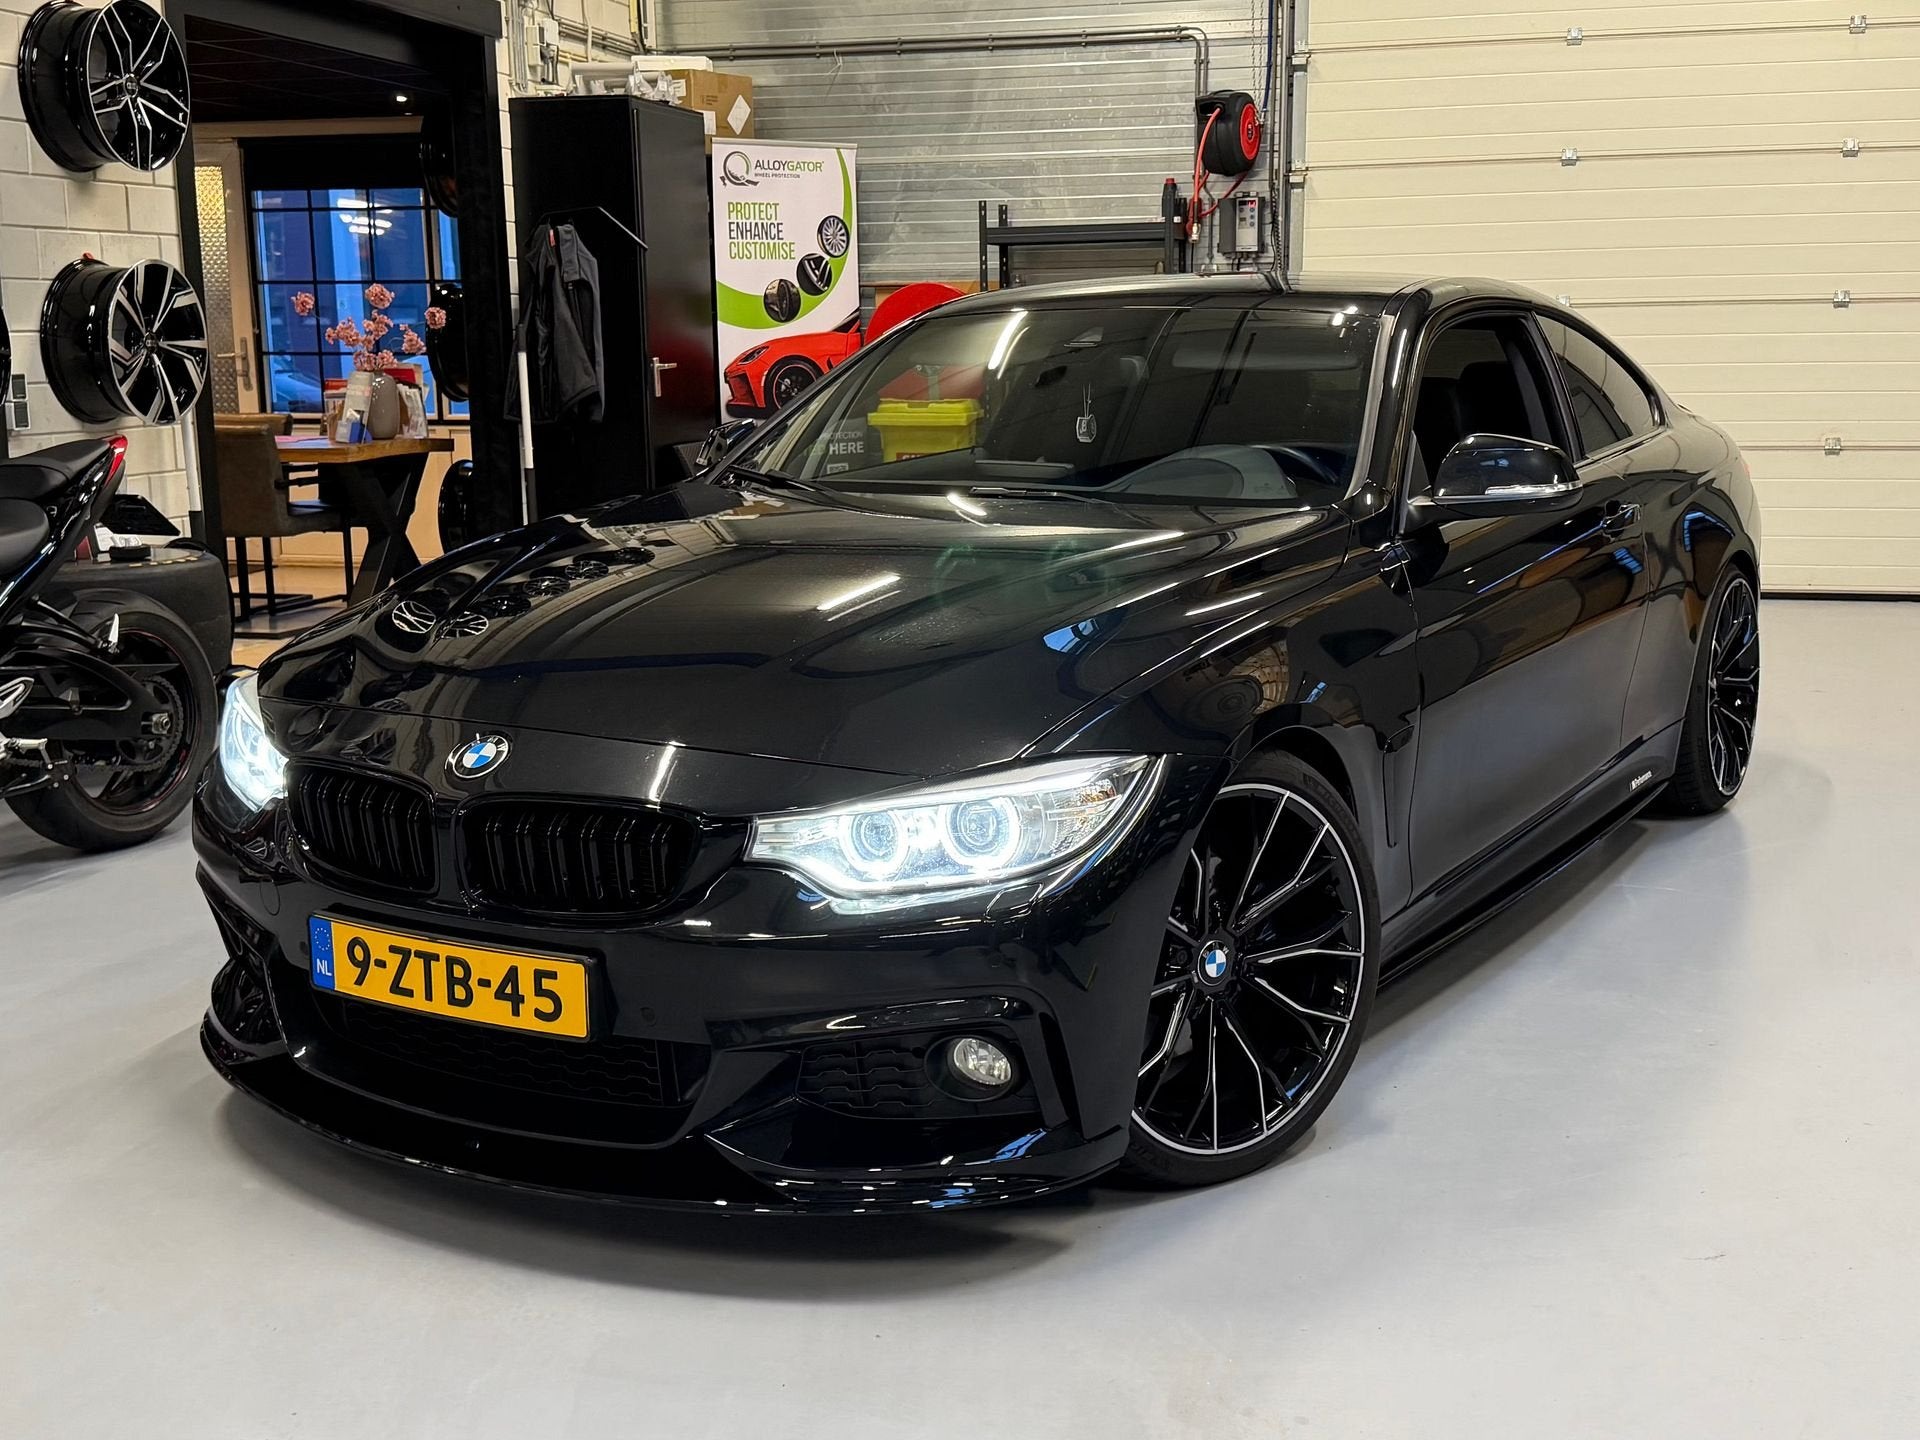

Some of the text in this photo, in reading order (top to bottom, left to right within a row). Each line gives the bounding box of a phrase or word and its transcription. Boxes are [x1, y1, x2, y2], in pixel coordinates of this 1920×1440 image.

[754, 159, 823, 173] ALLOYGATOR
[728, 201, 779, 221] PROTECT
[728, 221, 784, 241] ENHANCE
[729, 241, 796, 260] CUSTOMISE
[829, 441, 865, 455] HERE
[316, 958, 332, 976] NL
[346, 936, 562, 1023] 9-ZTB-45
